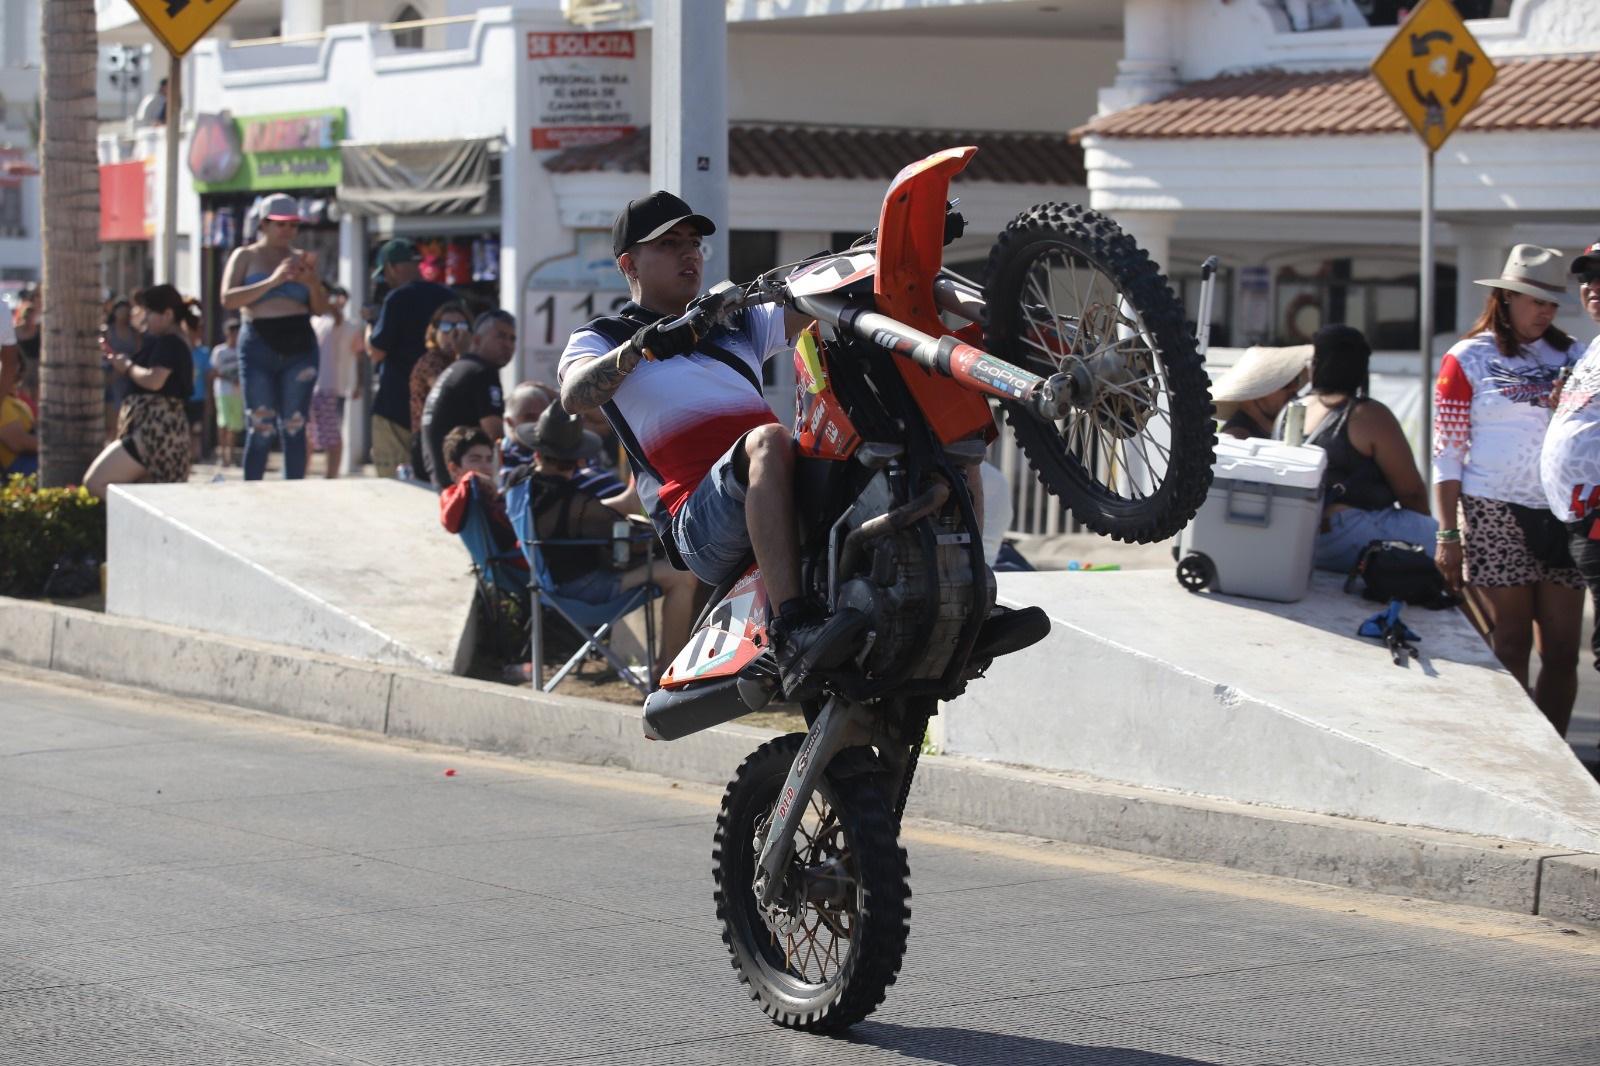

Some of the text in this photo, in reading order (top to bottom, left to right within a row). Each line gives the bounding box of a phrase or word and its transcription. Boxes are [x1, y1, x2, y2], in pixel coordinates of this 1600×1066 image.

[529, 34, 633, 54] SE SOLICITA
[538, 75, 629, 85] PERSONAL PARA
[601, 87, 616, 98] DE
[975, 359, 1028, 390] GoPro
